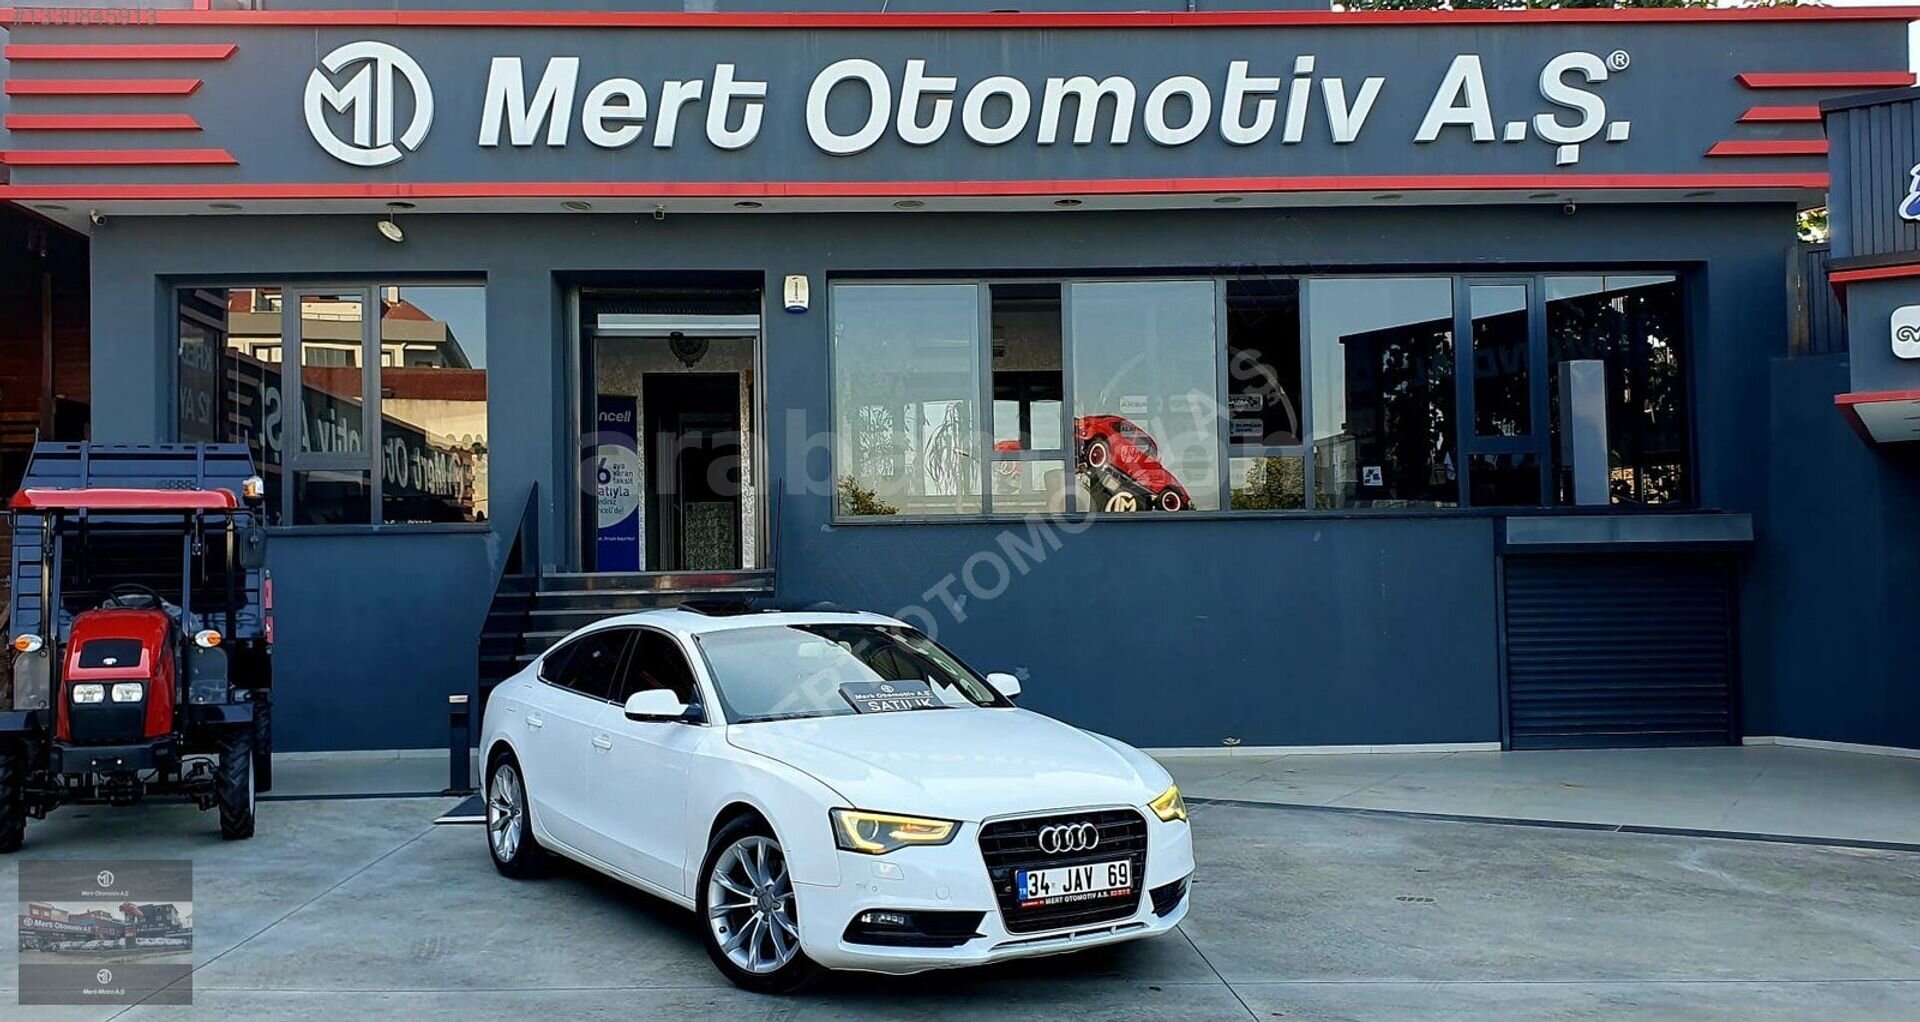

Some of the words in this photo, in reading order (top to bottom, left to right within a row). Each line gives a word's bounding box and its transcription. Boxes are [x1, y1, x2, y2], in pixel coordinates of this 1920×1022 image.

[478, 56, 767, 149] Mert
[806, 55, 1385, 155] Otomotiv
[1028, 871, 1050, 897] 34
[1063, 866, 1094, 893] JAV
[1107, 862, 1129, 887] 69
[1045, 894, 1064, 905] MERT
